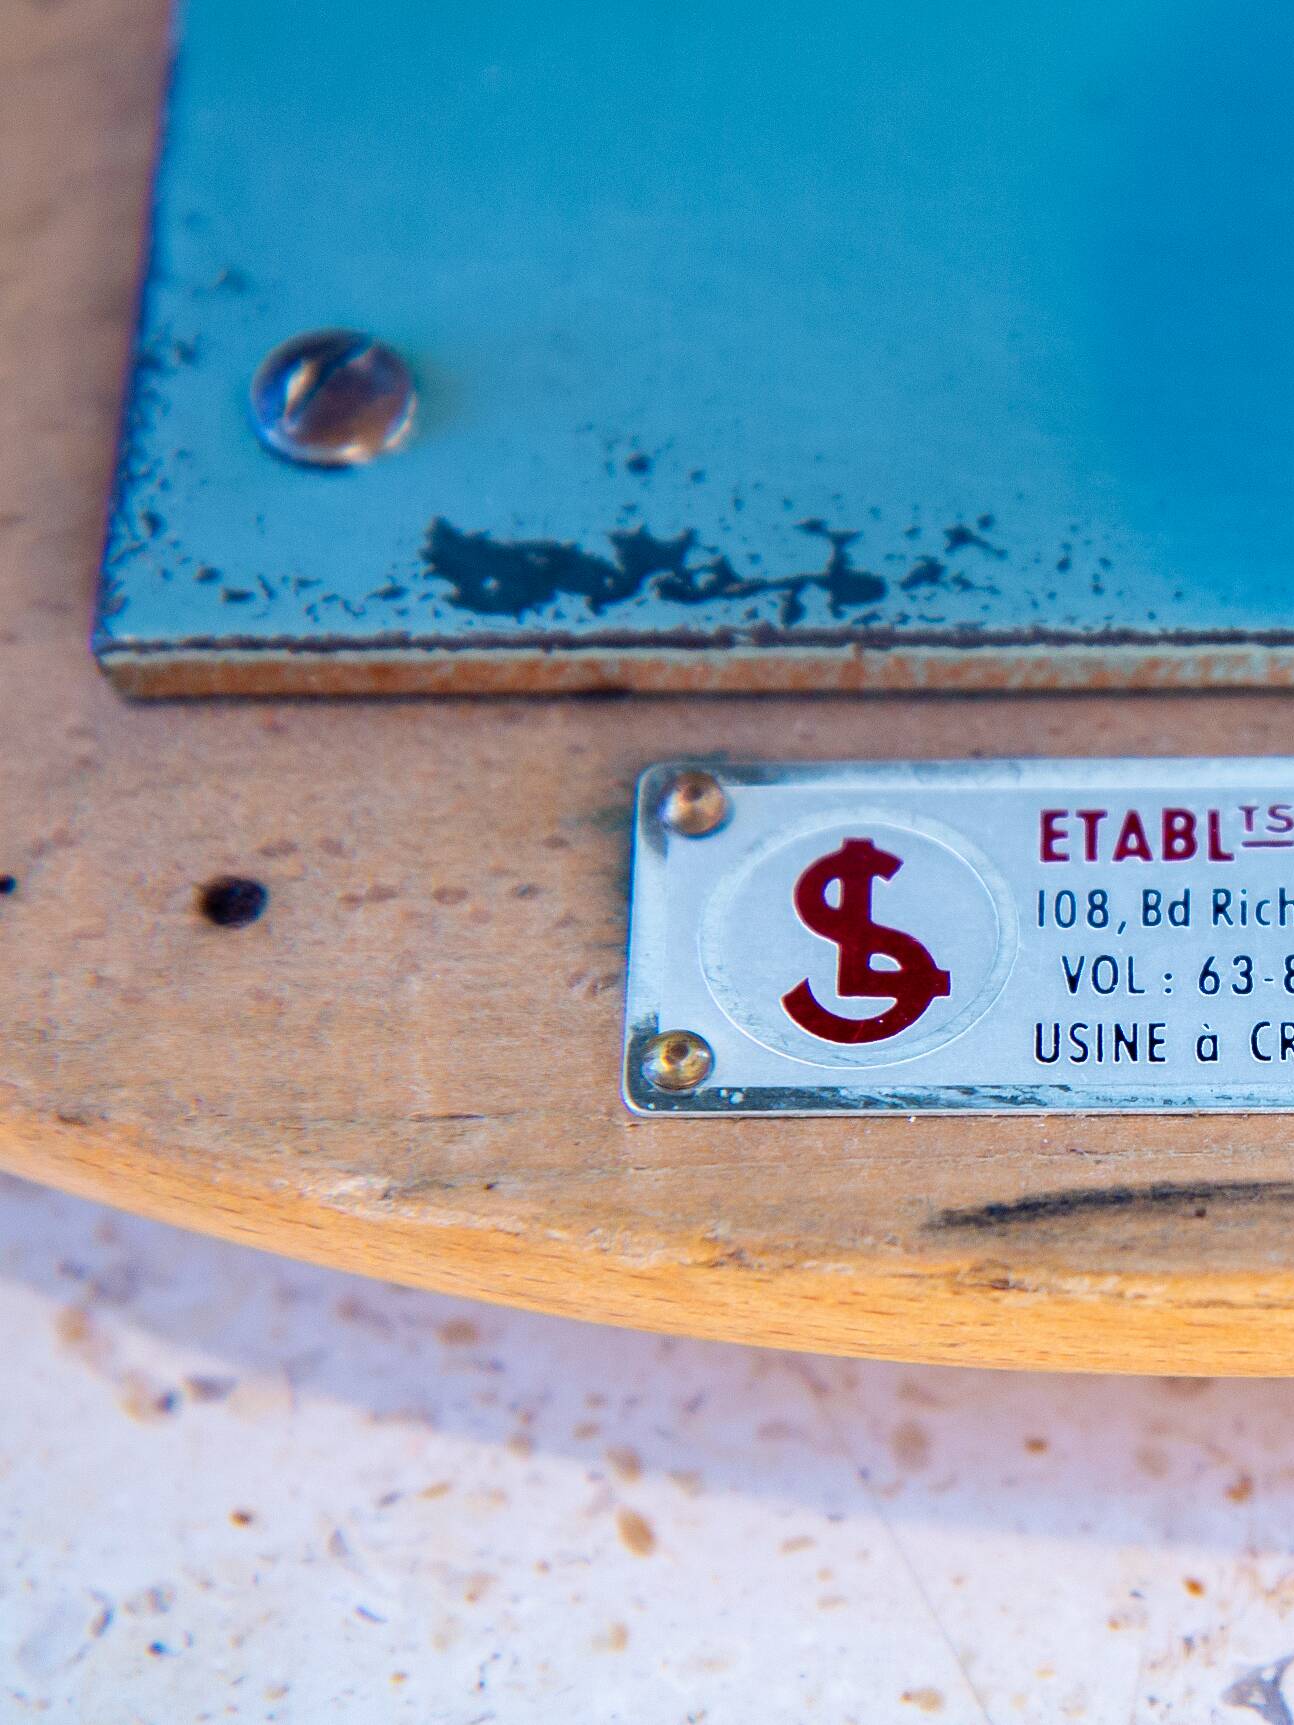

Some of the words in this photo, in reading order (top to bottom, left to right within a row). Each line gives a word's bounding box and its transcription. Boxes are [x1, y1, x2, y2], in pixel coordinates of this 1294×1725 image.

[1036, 888, 1127, 934] 108,
[1141, 888, 1191, 927] Bd
[1035, 1021, 1167, 1063] USINE
[1195, 1023, 1219, 1062] à
